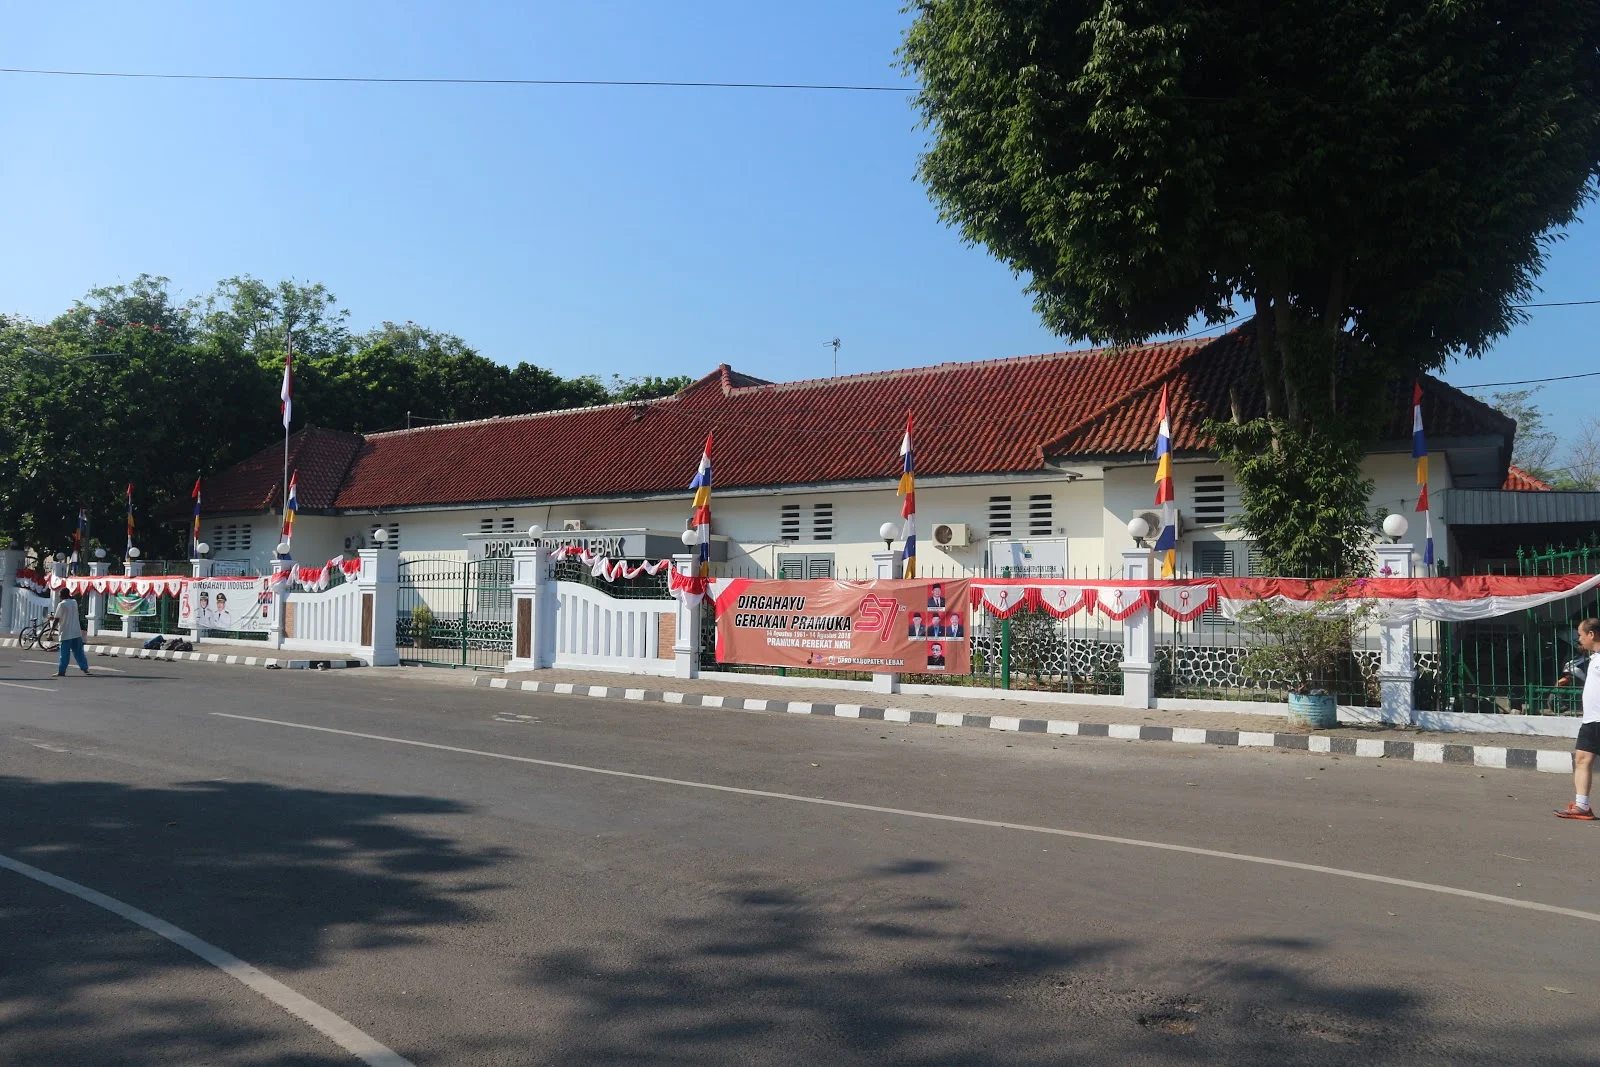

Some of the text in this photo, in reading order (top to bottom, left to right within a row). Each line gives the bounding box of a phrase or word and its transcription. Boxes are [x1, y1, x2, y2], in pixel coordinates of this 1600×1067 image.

[485, 540, 511, 557] DPRD
[193, 581, 254, 590] DIRGAHAYU INDONESIA
[737, 595, 806, 611] DIRGAHAYU
[735, 613, 852, 631] GERAKAN PRAMUKA
[767, 637, 851, 649] PRAMUKA PEREKAT NKRI
[852, 657, 885, 665] KABUPATEN
[885, 658, 904, 666] LEBAK
